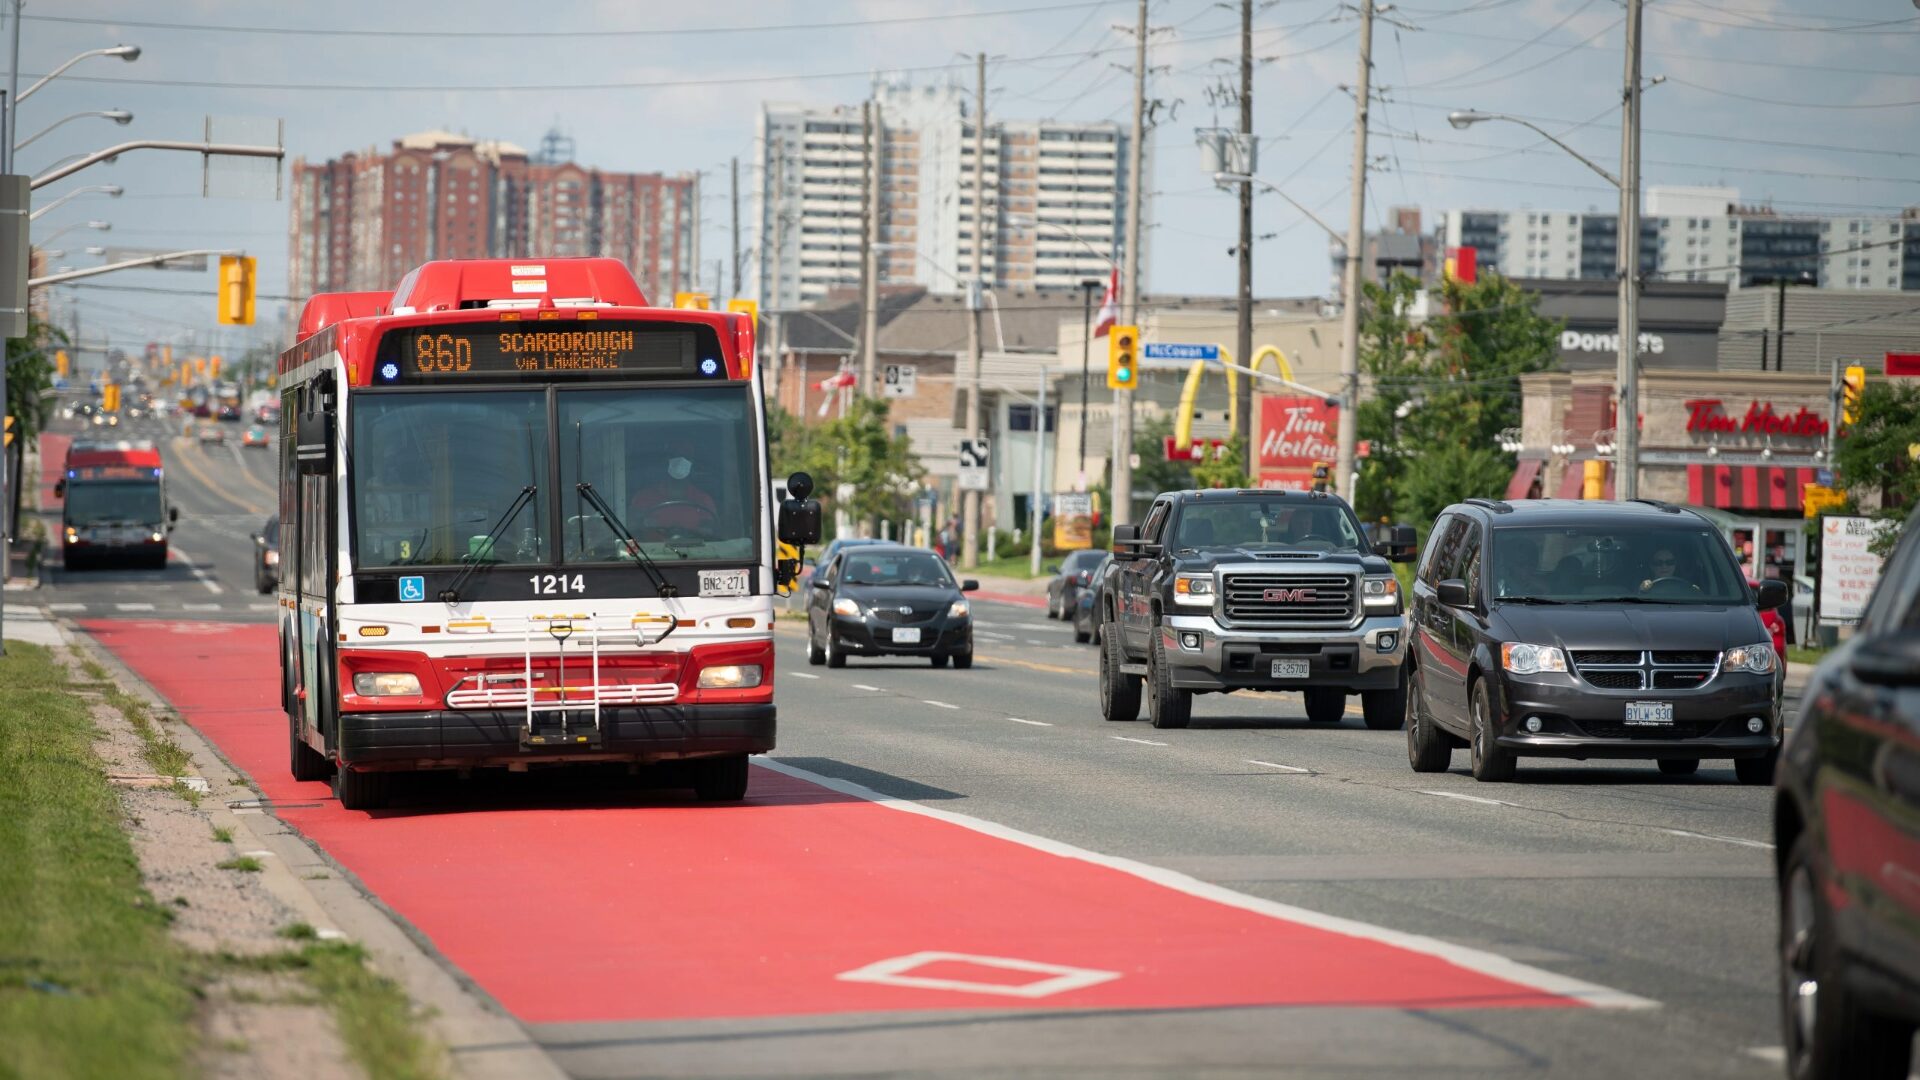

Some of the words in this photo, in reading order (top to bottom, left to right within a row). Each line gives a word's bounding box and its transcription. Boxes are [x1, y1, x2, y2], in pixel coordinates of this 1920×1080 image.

[499, 331, 633, 353] SCARBOROUGH
[1149, 344, 1203, 358] McCowan
[416, 334, 472, 373] 86D
[544, 351, 618, 369] LAWRENCE
[1284, 407, 1326, 434] Tim
[1684, 399, 1738, 433] Tim
[1741, 399, 1831, 436] Horton
[1261, 429, 1338, 459] Horton
[1846, 519, 1866, 528] ASH
[401, 541, 411, 559] 3
[529, 574, 586, 594] 1214
[1263, 588, 1317, 602] GMC
